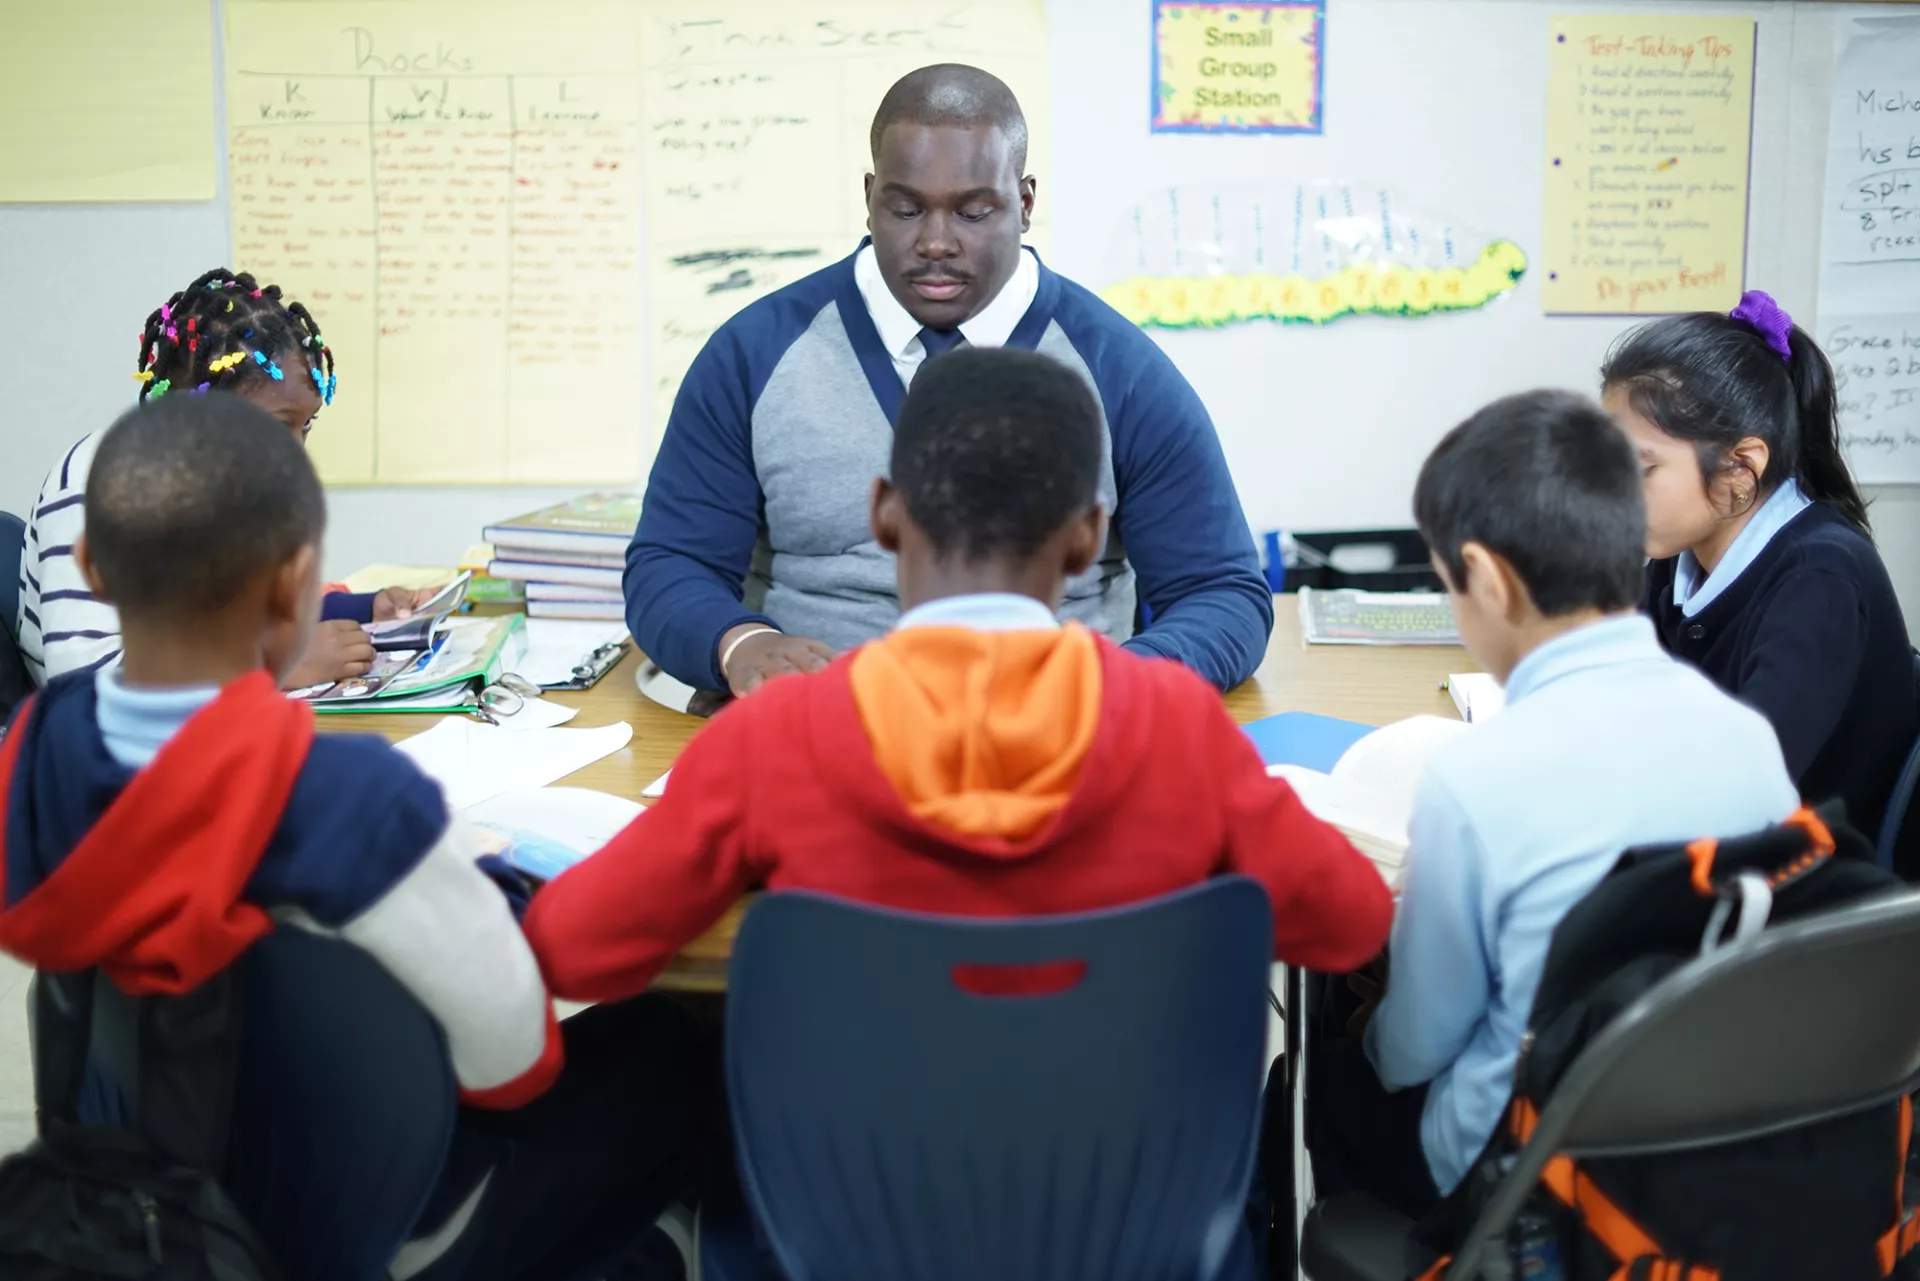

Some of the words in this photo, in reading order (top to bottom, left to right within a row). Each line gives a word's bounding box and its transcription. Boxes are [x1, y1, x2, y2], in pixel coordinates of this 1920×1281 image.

[1204, 26, 1274, 48] Small
[1697, 35, 1734, 70] Tips
[1197, 56, 1278, 80] Group
[285, 79, 308, 104] K
[409, 79, 450, 106] W
[558, 80, 583, 103] L
[1193, 86, 1282, 108] Station
